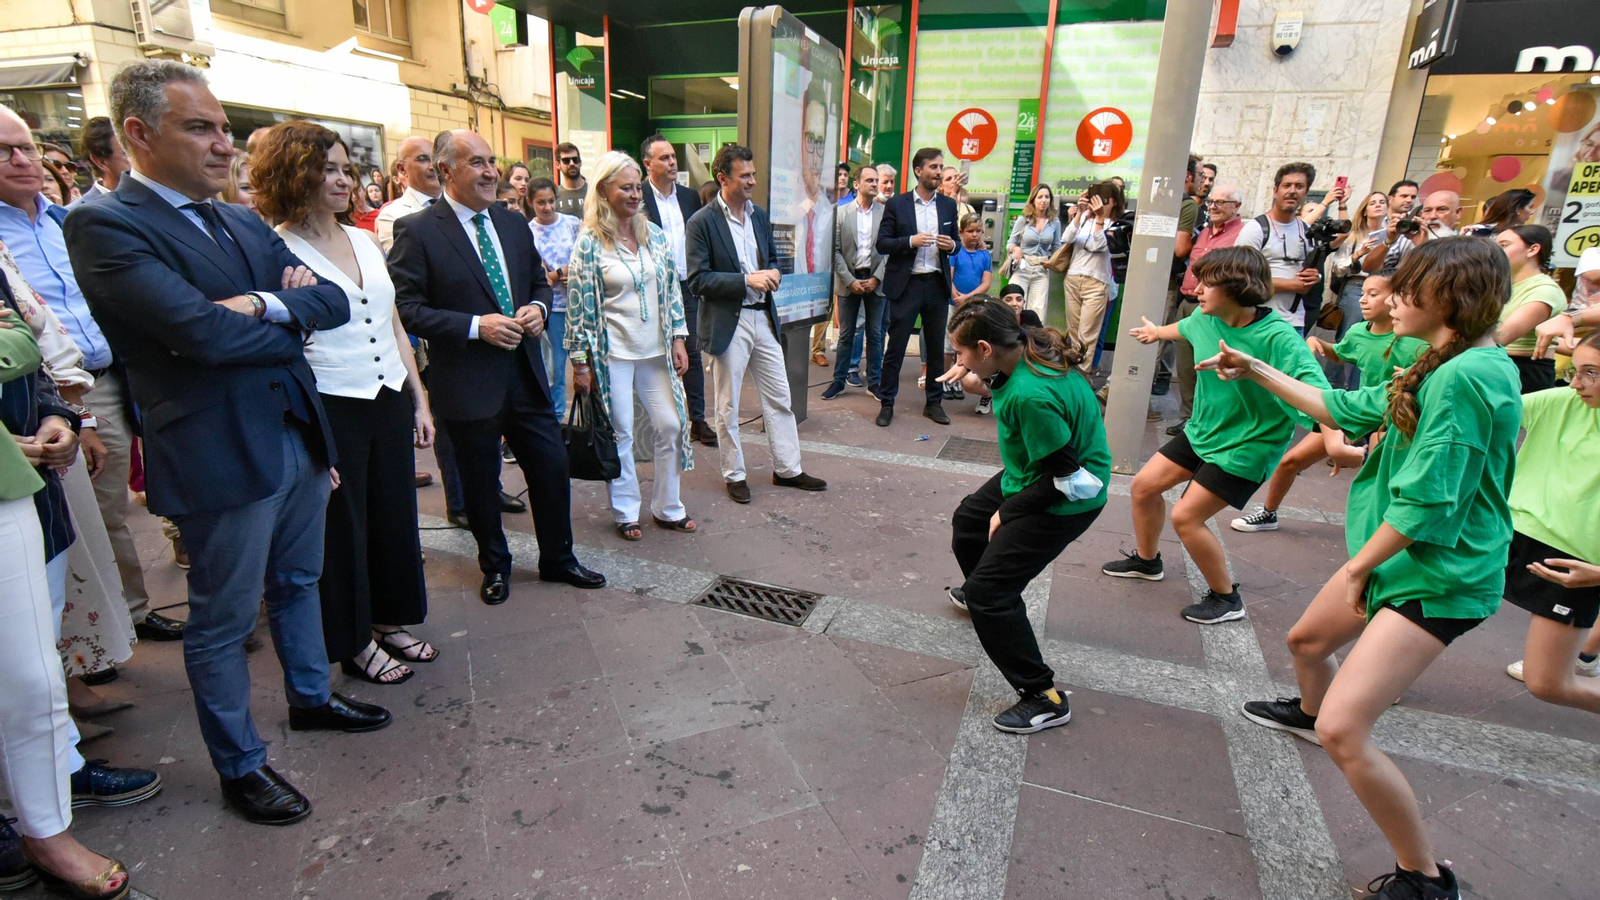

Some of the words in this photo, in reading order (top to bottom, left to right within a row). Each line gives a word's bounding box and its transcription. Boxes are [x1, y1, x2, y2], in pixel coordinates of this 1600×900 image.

[500, 20, 513, 37] 24
[860, 52, 899, 67] Unicaja
[1515, 45, 1600, 72] m
[568, 74, 595, 86] Unicaja
[1017, 111, 1034, 134] 24
[1562, 201, 1582, 223] 2
